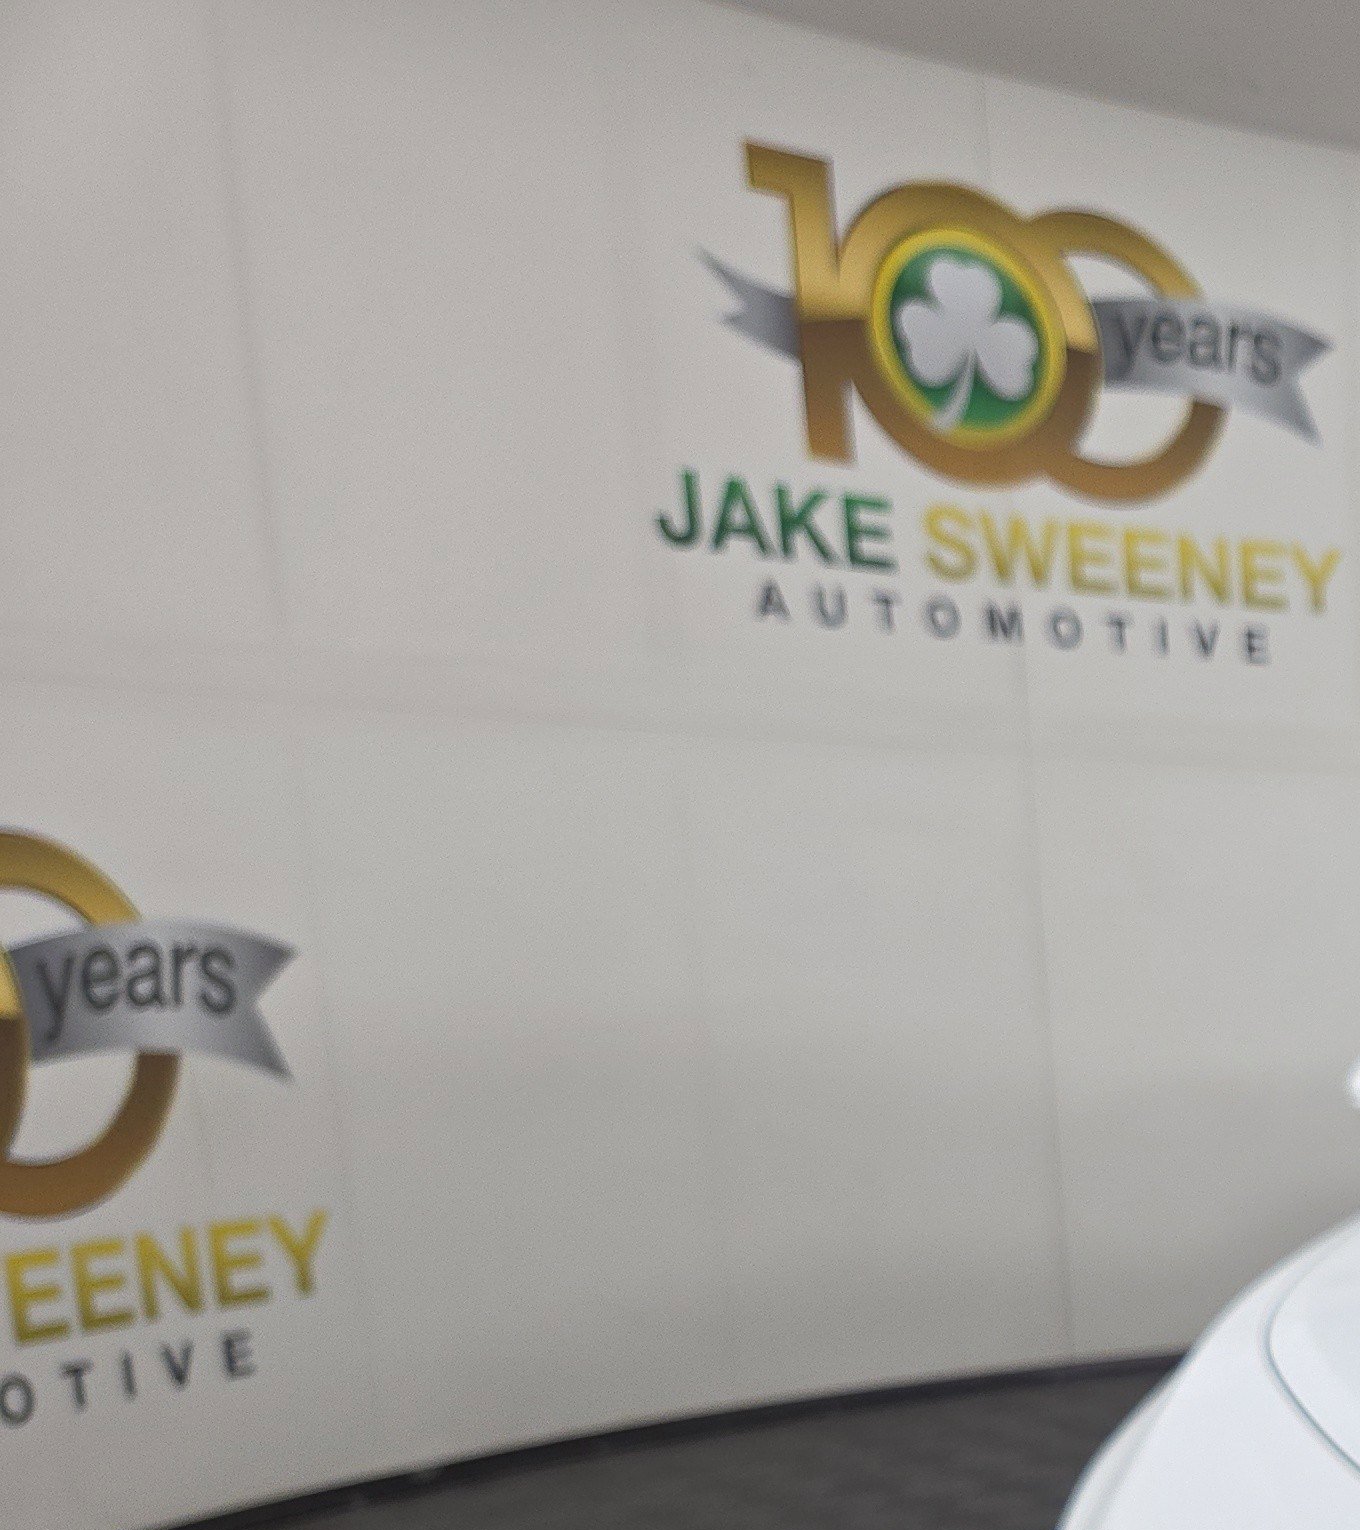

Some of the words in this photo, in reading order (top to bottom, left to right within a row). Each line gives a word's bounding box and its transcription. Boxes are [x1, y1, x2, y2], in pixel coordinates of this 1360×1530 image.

[1117, 306, 1284, 388] years
[656, 468, 896, 572] JAKE
[921, 504, 1341, 612] SWEENEY
[755, 580, 1270, 664] AUTOMOTIVE
[37, 935, 237, 1043] years
